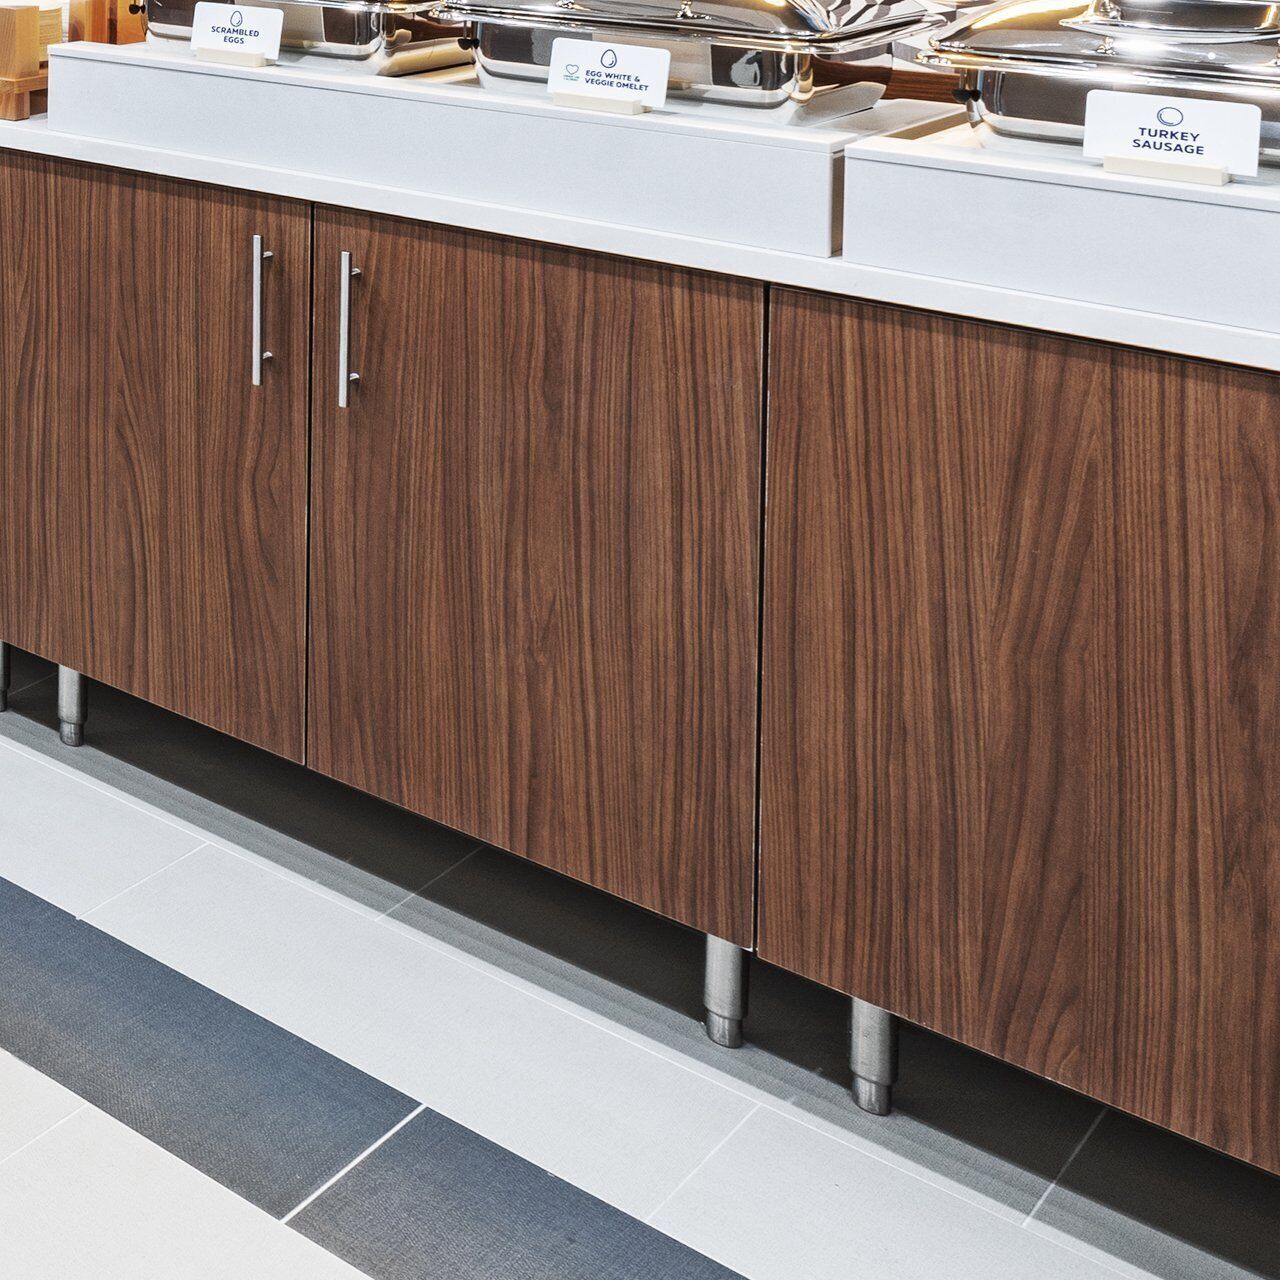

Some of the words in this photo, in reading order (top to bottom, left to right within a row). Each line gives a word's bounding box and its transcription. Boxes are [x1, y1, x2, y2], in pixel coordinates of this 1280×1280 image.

[211, 25, 260, 37] SCRAMBLED
[223, 35, 245, 44] EGGS
[585, 69, 602, 78] EGG
[604, 72, 632, 82] WHITE
[633, 75, 640, 83] &
[584, 77, 614, 87] VEGGIE
[615, 81, 649, 91] OMELET
[1138, 127, 1200, 142] TURKEY
[1132, 139, 1204, 155] SAUSAGE
